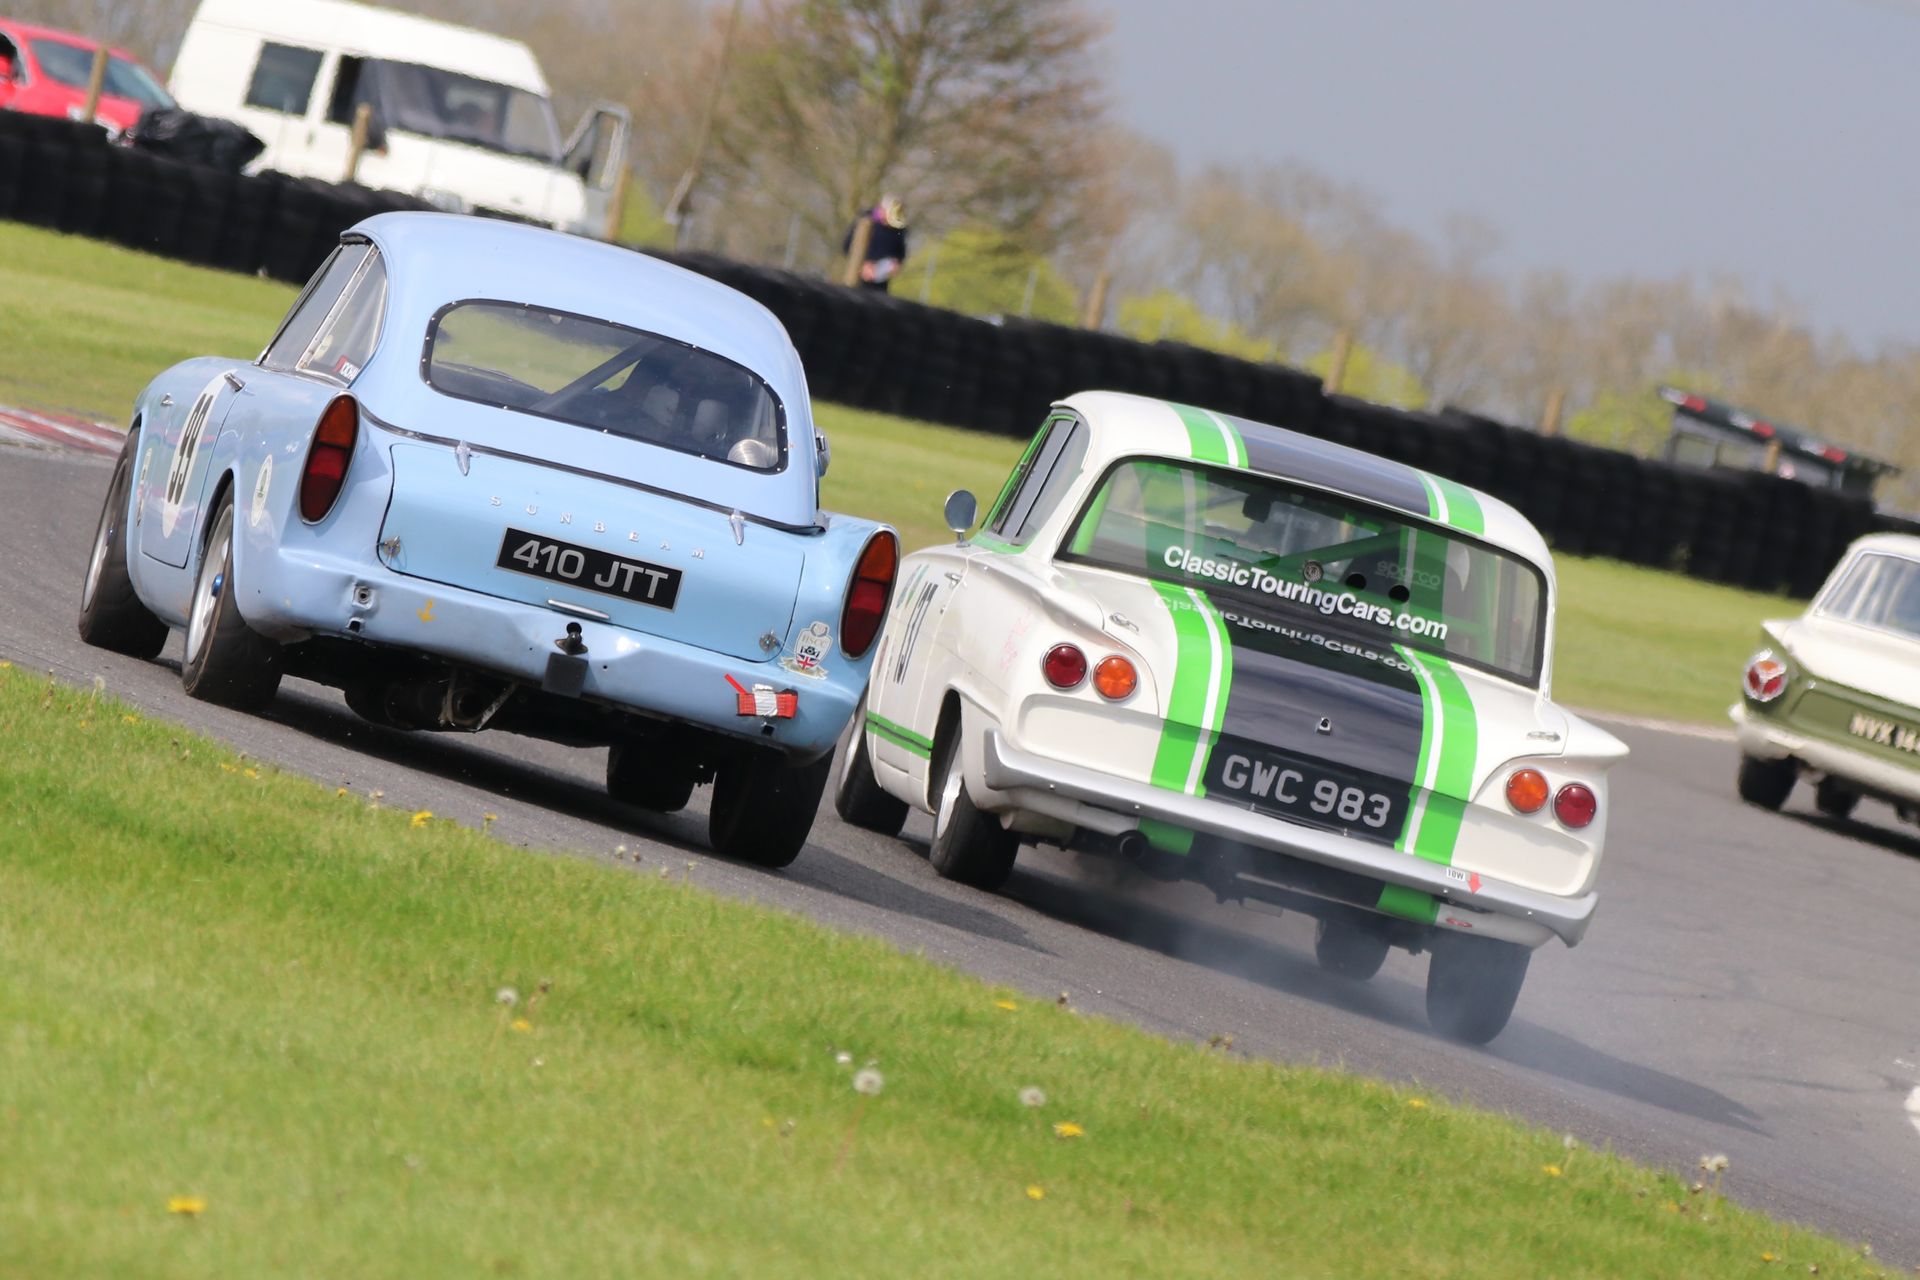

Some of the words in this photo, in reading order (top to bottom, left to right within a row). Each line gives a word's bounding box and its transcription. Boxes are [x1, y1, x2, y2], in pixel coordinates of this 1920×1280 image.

[167, 393, 214, 505] 99
[490, 495, 705, 559] SUNBEAM
[512, 539, 586, 579] 410
[594, 560, 669, 600] JTT
[1163, 545, 1448, 640] ClassicTouringCars.com
[1222, 754, 1304, 804] GWC
[1310, 780, 1391, 828] 983
